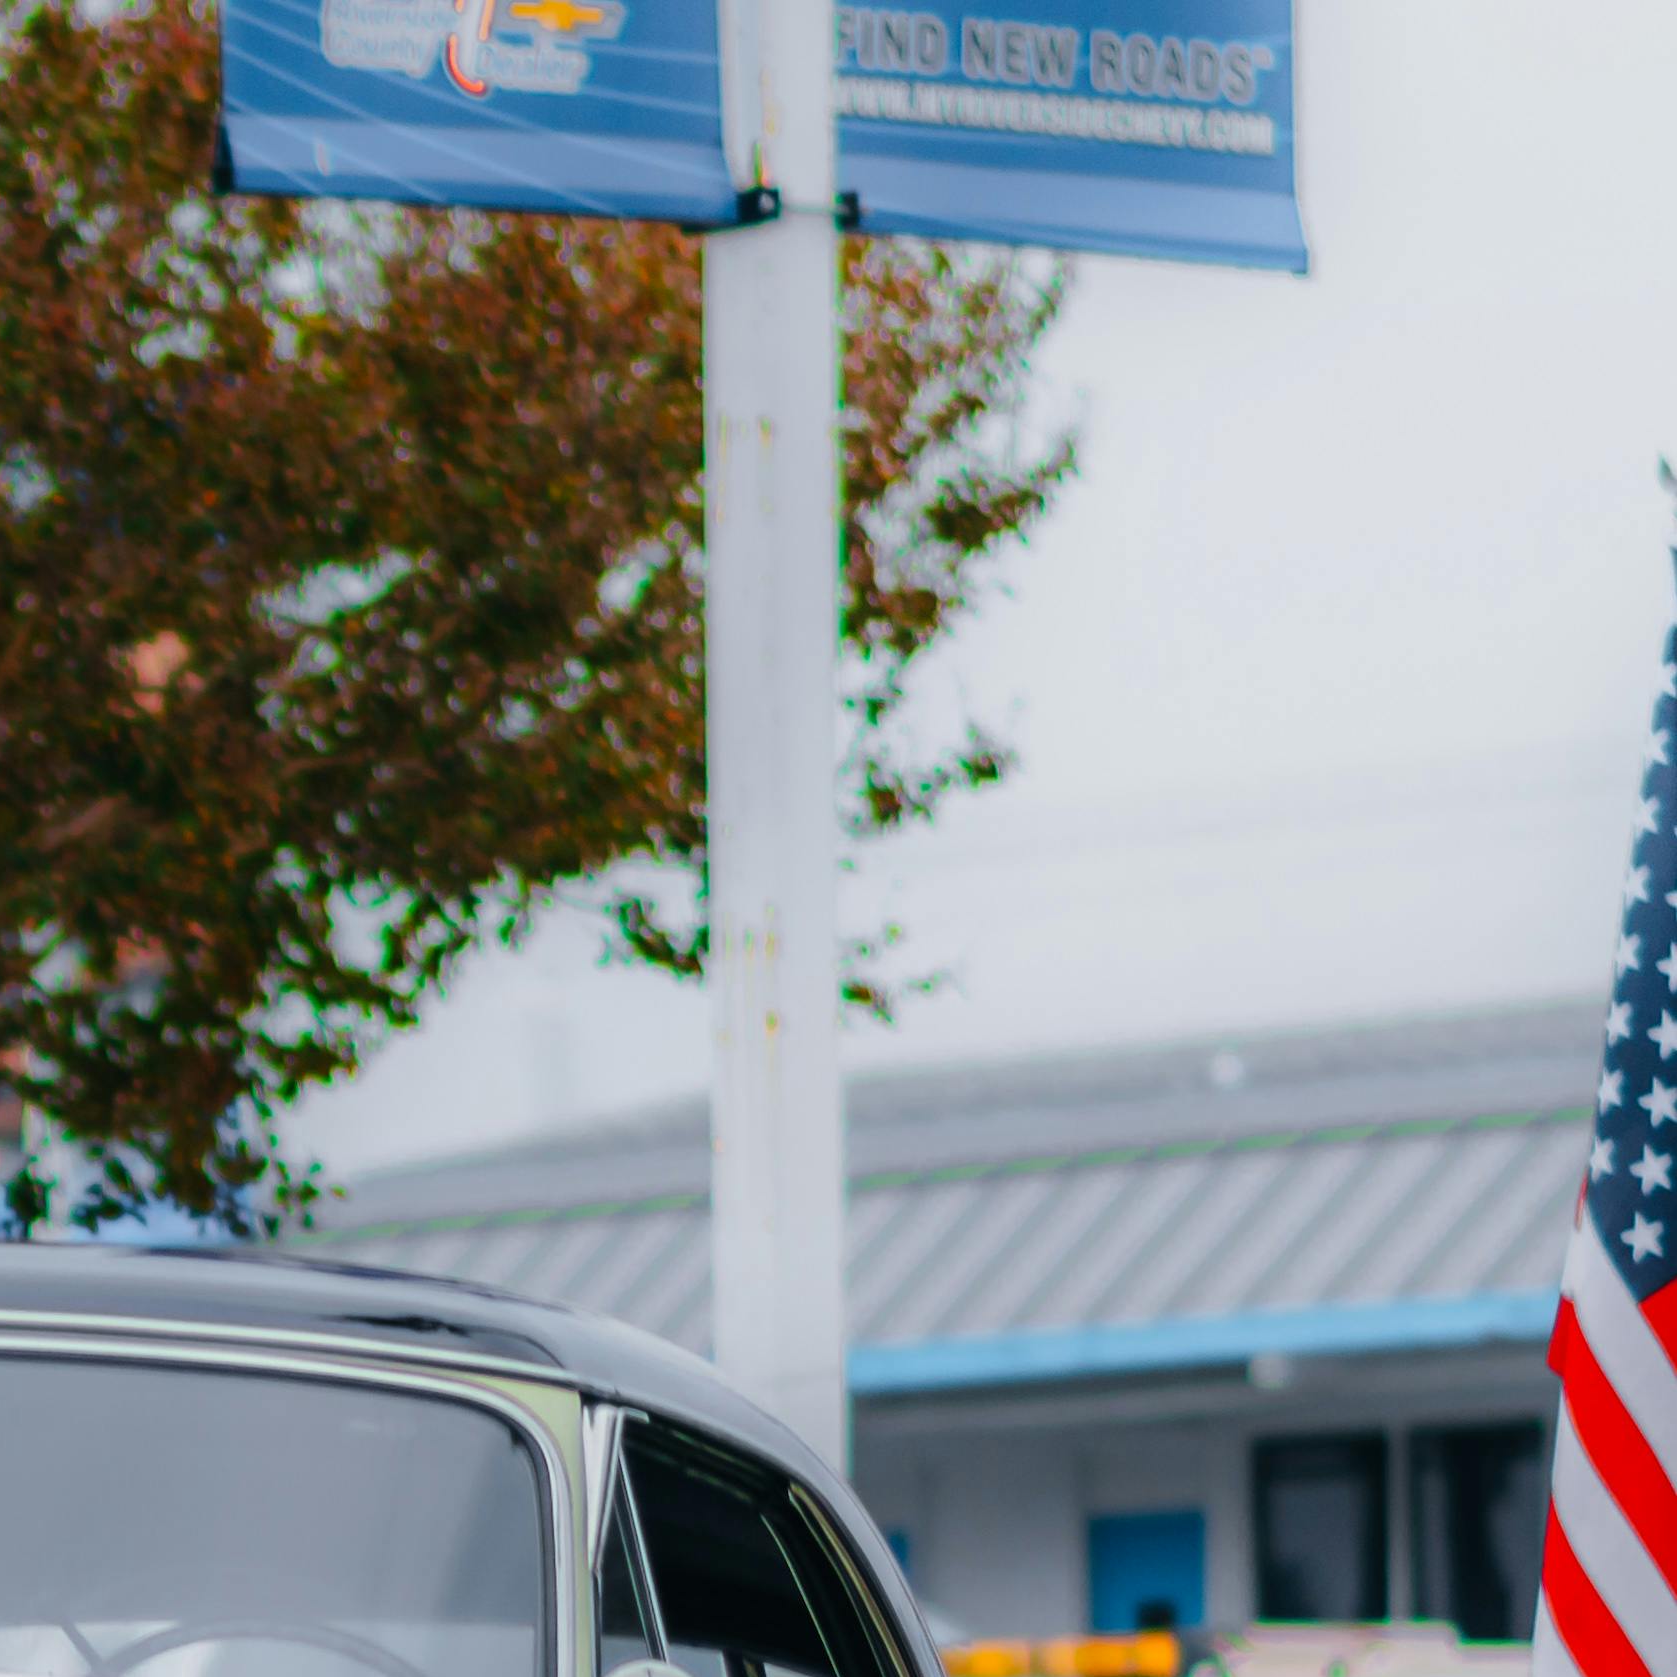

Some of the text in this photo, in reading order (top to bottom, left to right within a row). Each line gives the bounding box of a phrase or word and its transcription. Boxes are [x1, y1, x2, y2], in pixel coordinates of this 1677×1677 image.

[833, 8, 1257, 105] FIND NEW ROADS
